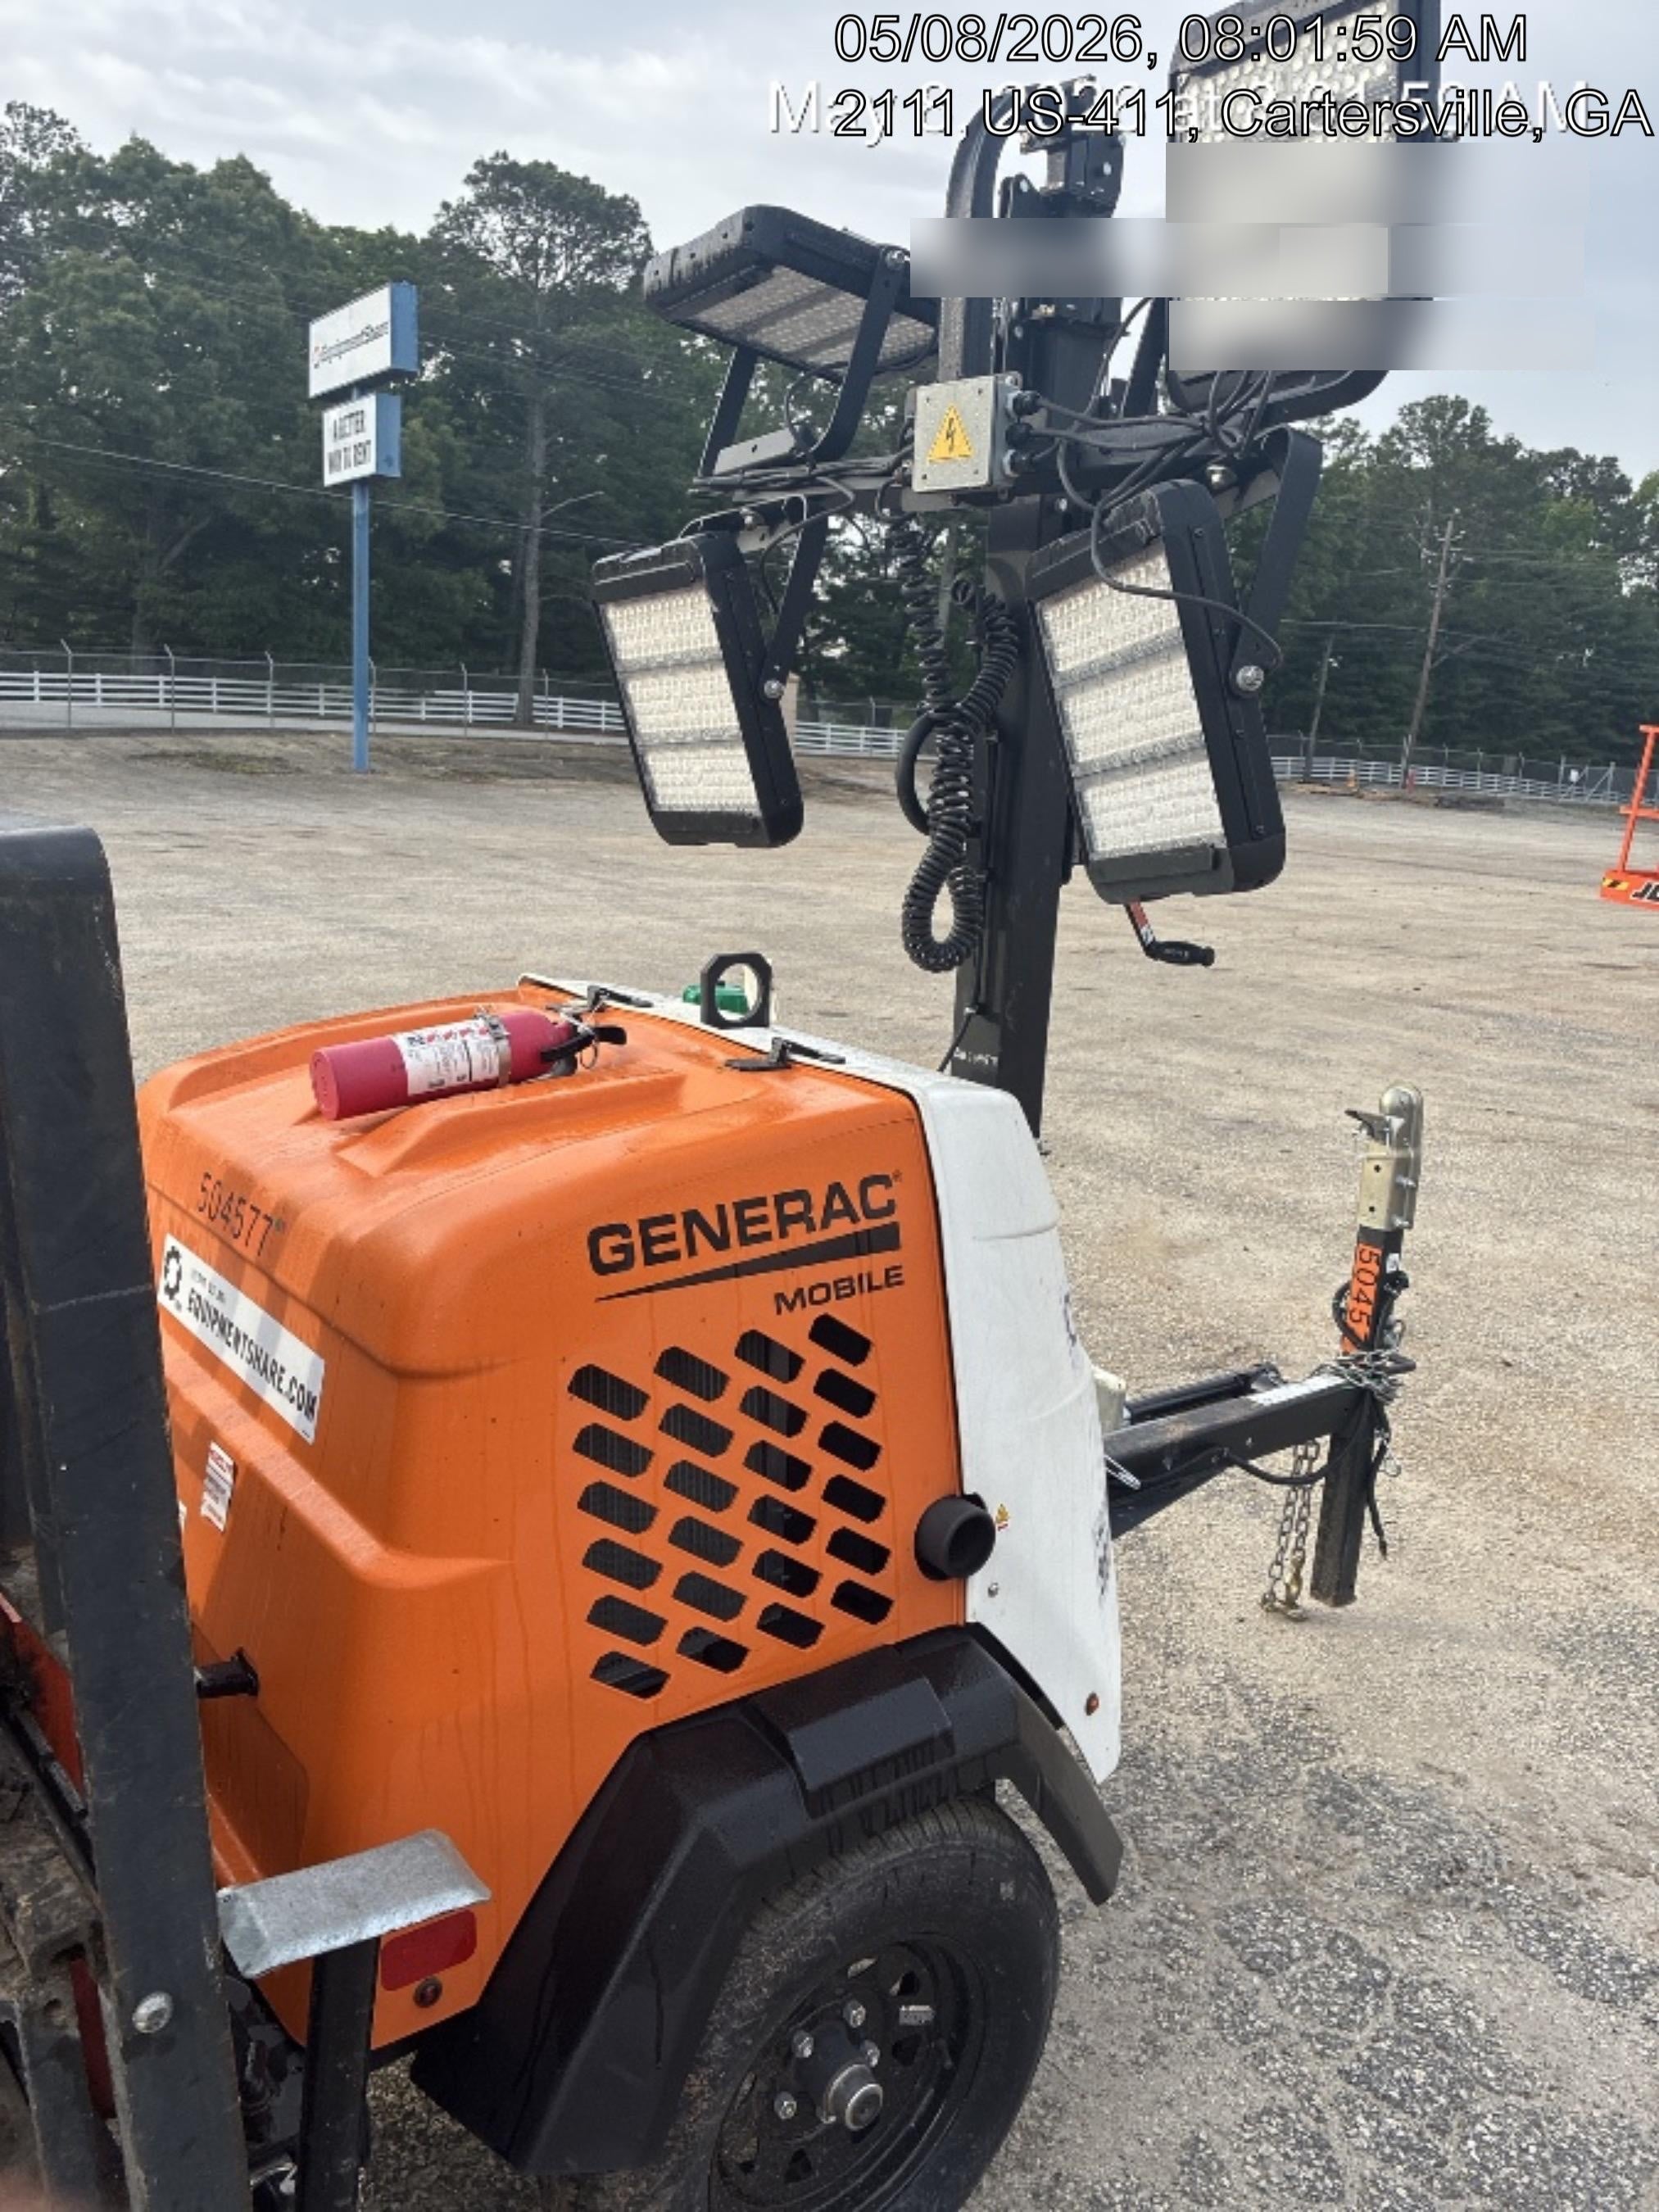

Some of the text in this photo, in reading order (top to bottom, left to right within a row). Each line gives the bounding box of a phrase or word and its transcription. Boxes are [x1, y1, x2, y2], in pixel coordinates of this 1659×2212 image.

[198, 1172, 273, 1257] 504577
[587, 1173, 895, 1276] GENERAC
[773, 1265, 904, 1315] MOBILE
[1349, 1248, 1380, 1340] 5045
